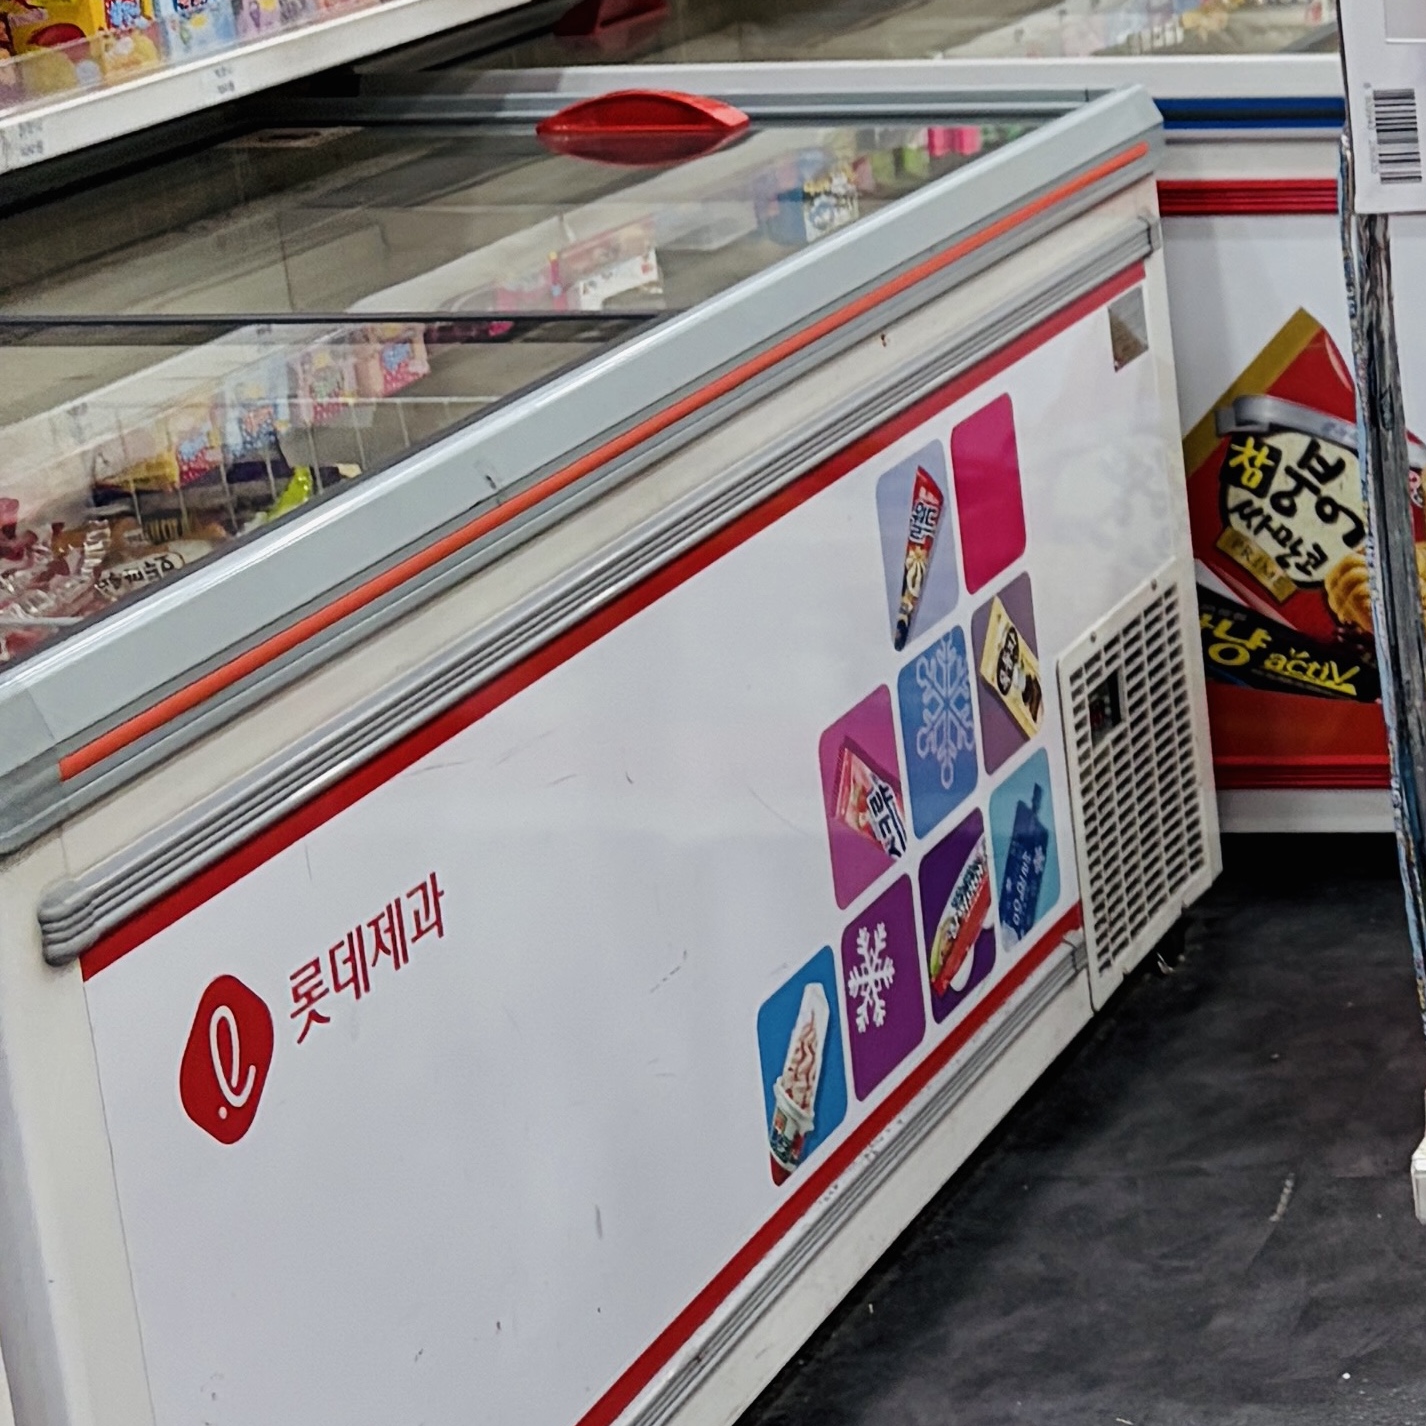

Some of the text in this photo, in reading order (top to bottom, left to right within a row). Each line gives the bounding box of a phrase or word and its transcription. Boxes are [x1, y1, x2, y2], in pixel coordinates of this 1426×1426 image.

[1227, 436, 1368, 550] 참 붕어
[1228, 498, 1329, 577] 싸만코
[289, 871, 445, 1046] 롯데제과
